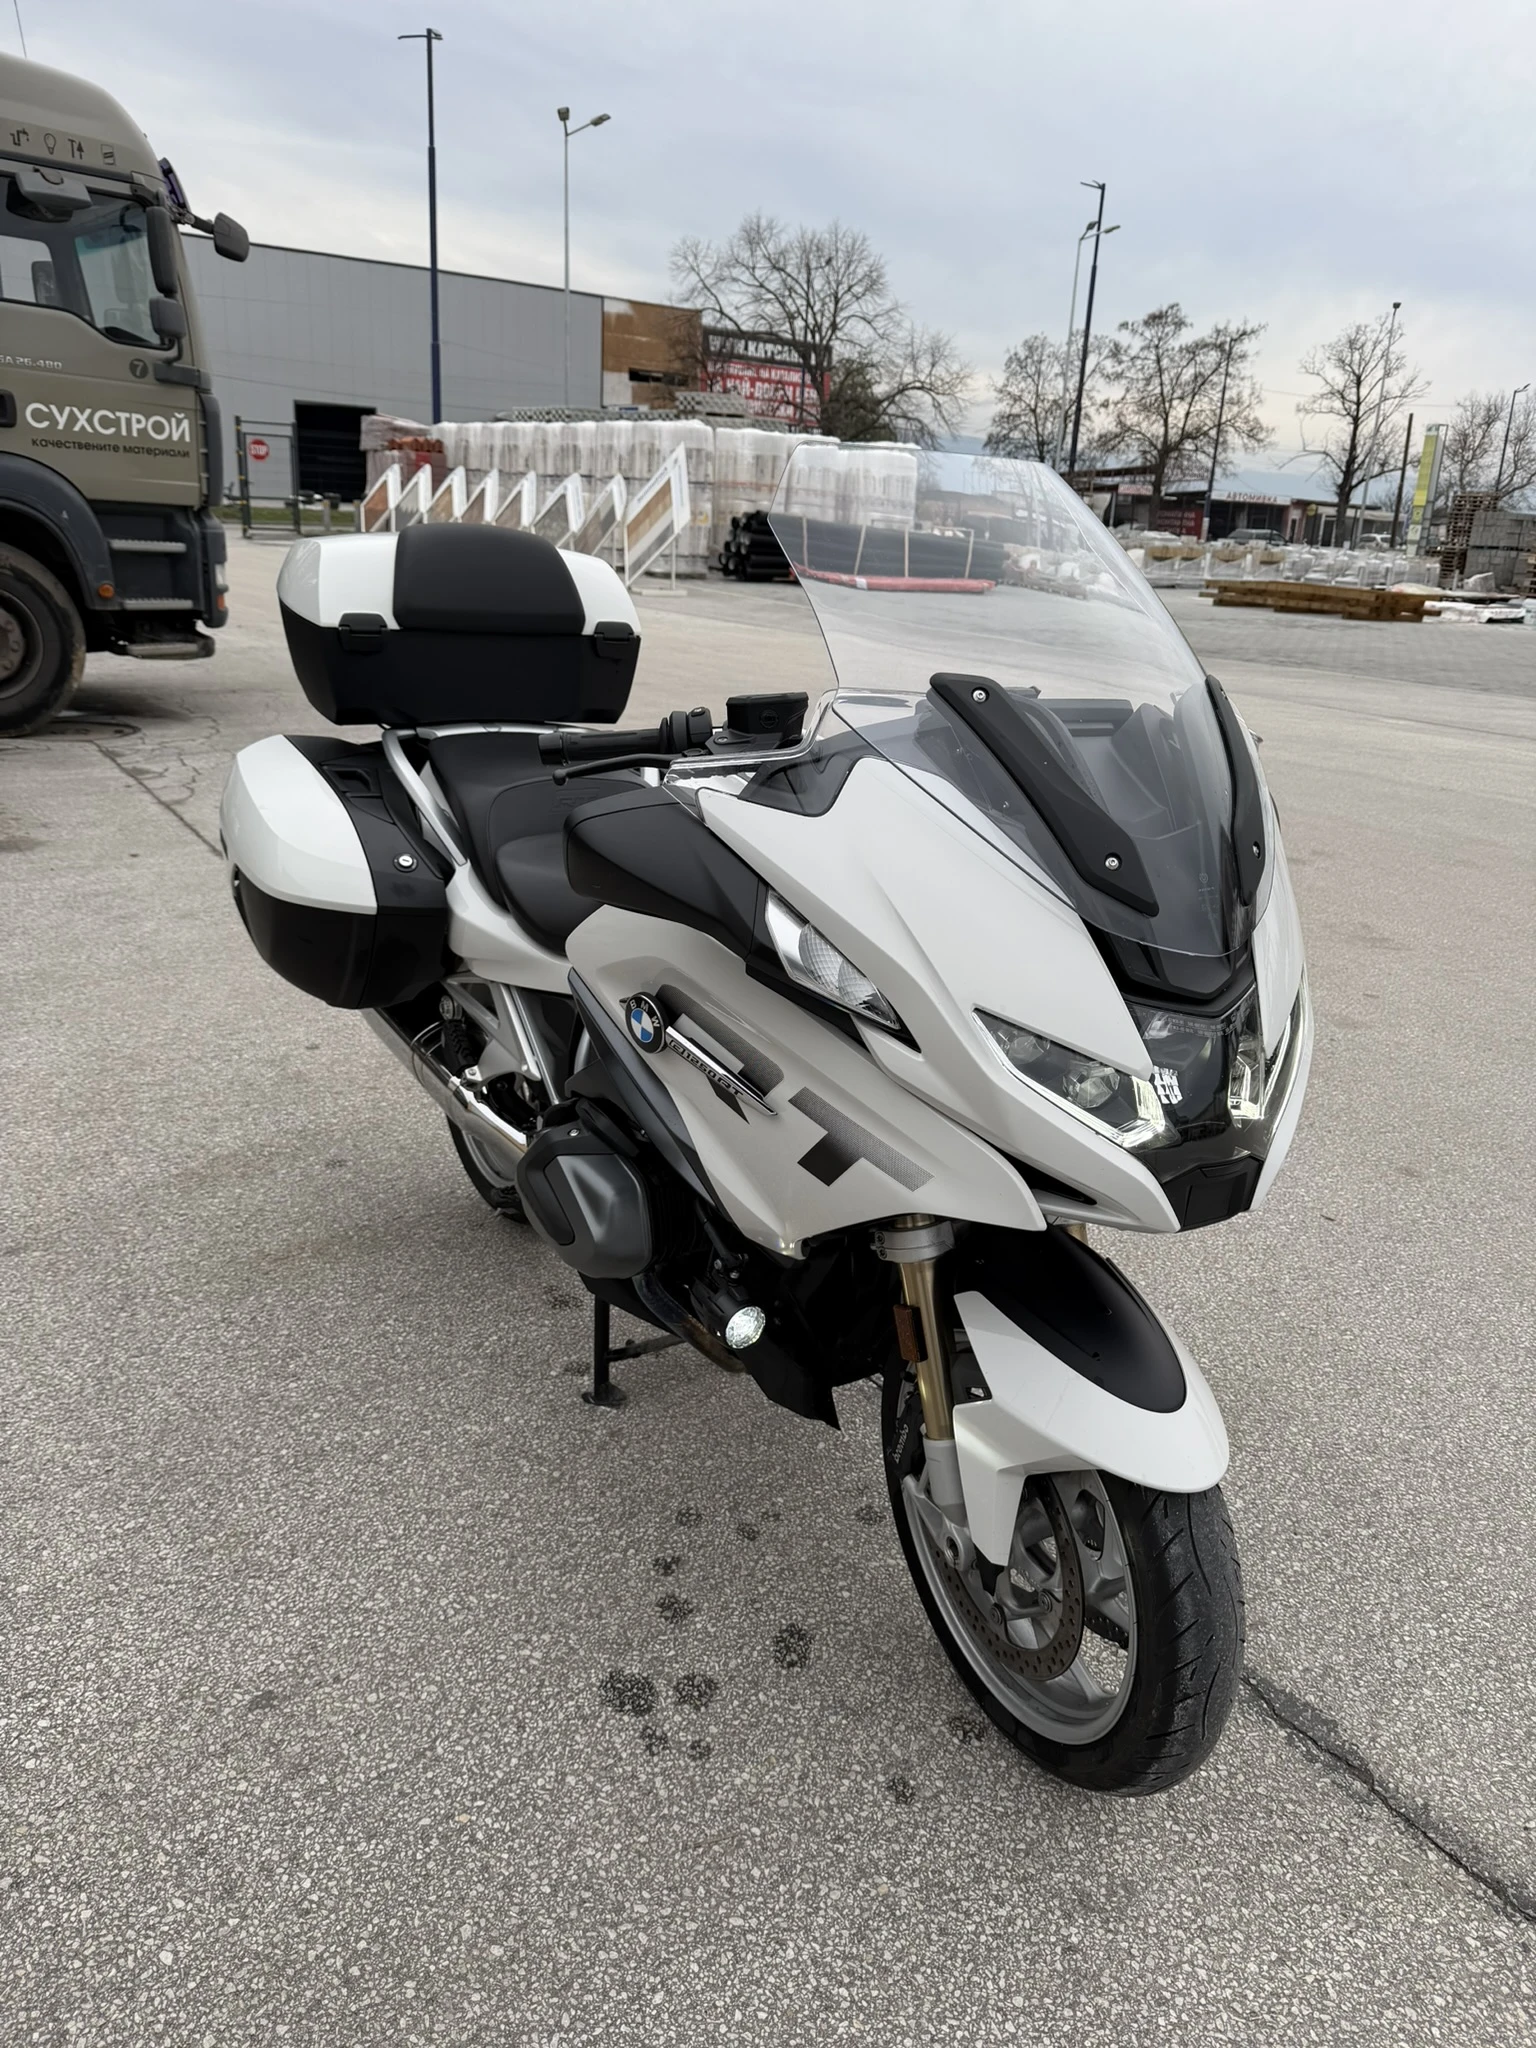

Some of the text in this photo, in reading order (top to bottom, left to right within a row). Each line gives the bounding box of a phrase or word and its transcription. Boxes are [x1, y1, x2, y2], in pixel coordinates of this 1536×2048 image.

[25, 402, 191, 443] СУХСТРОЙ
[32, 437, 190, 459] качествените материали
[250, 444, 268, 456] STOP
[1226, 491, 1278, 503] АВТОМИВКА
[630, 1000, 660, 1027] BMW
[892, 1424, 908, 1464] brembo
